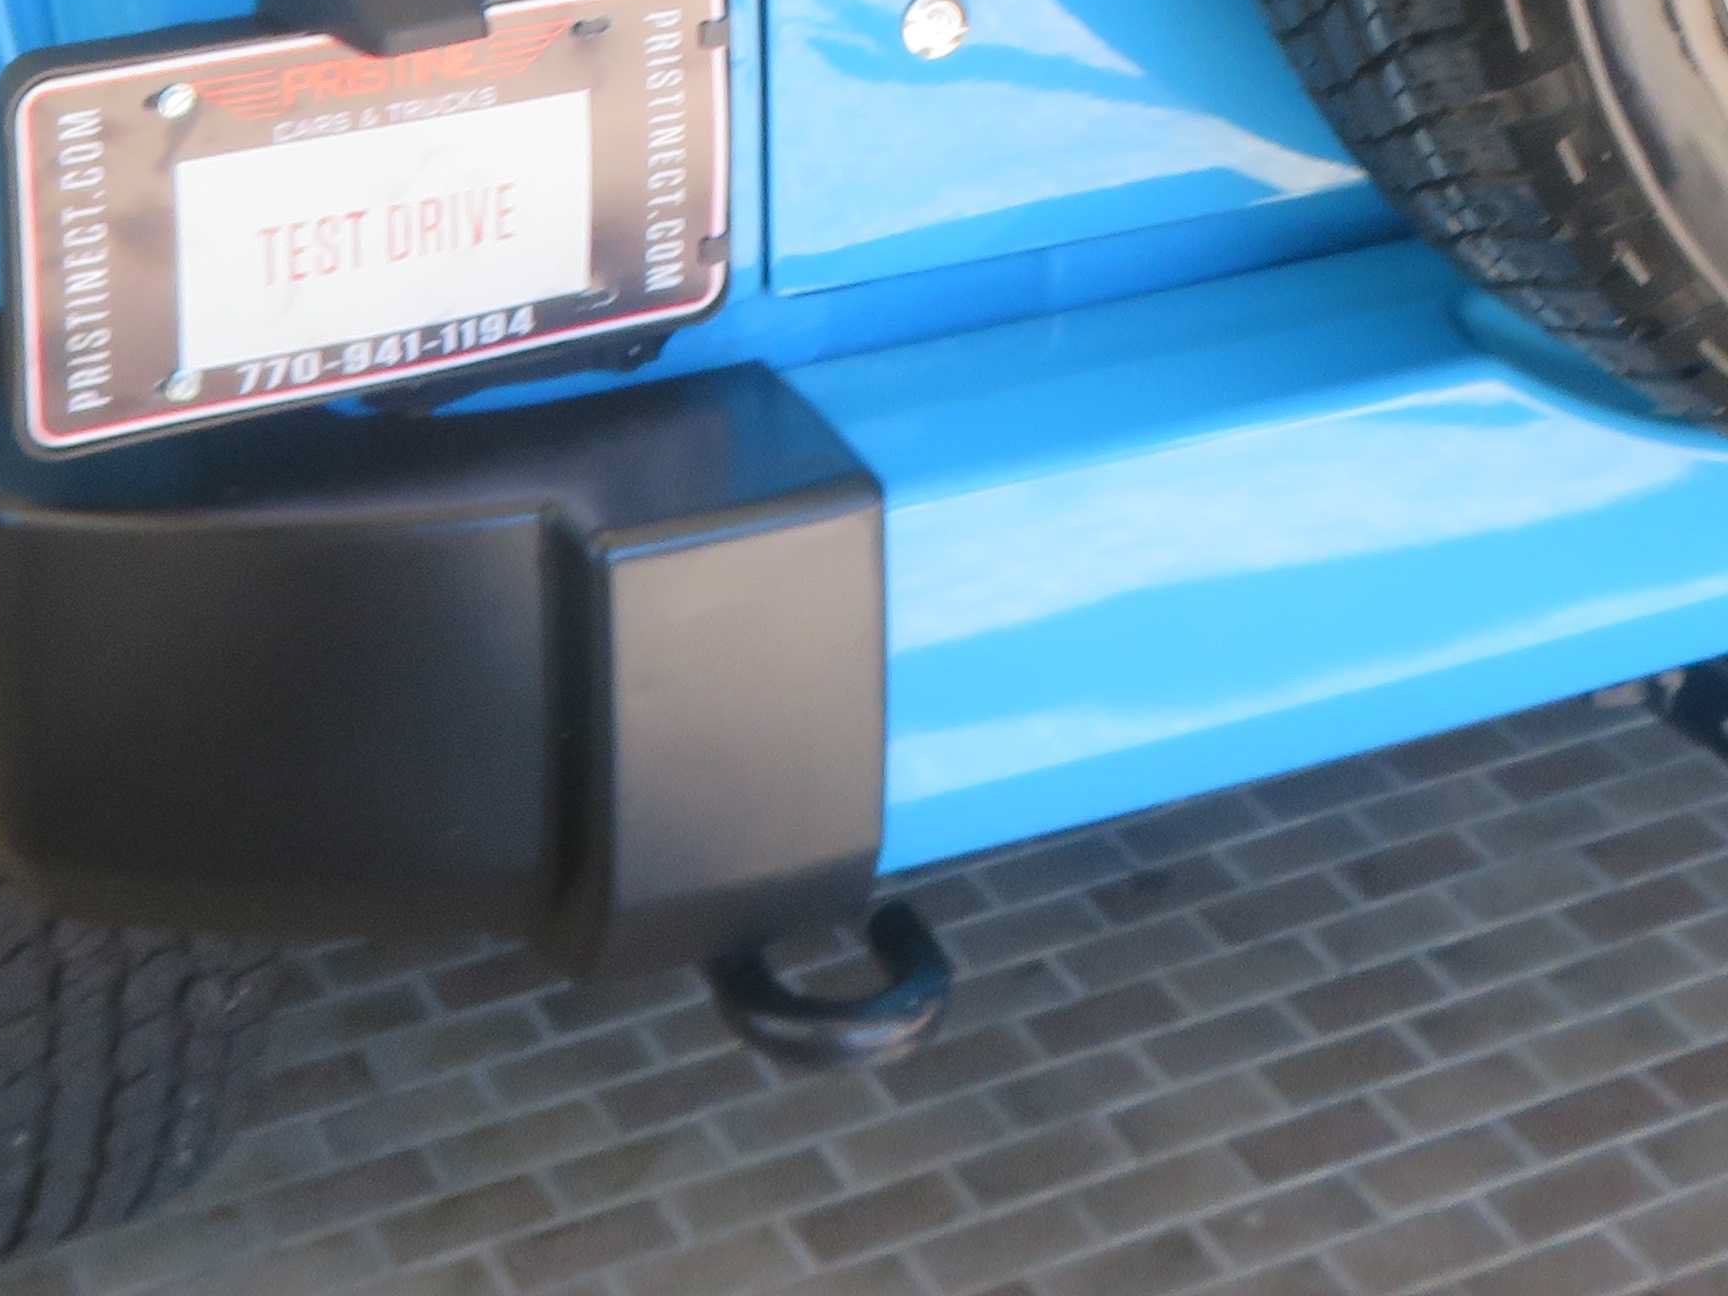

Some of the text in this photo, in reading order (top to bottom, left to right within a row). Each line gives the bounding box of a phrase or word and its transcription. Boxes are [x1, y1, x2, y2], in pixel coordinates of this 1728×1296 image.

[256, 181, 518, 288] TEST DRIVE
[644, 8, 687, 294] PRISTINECT.COM
[58, 107, 112, 414] PRISTINECT.COM
[236, 306, 537, 396] 770-941-1194
